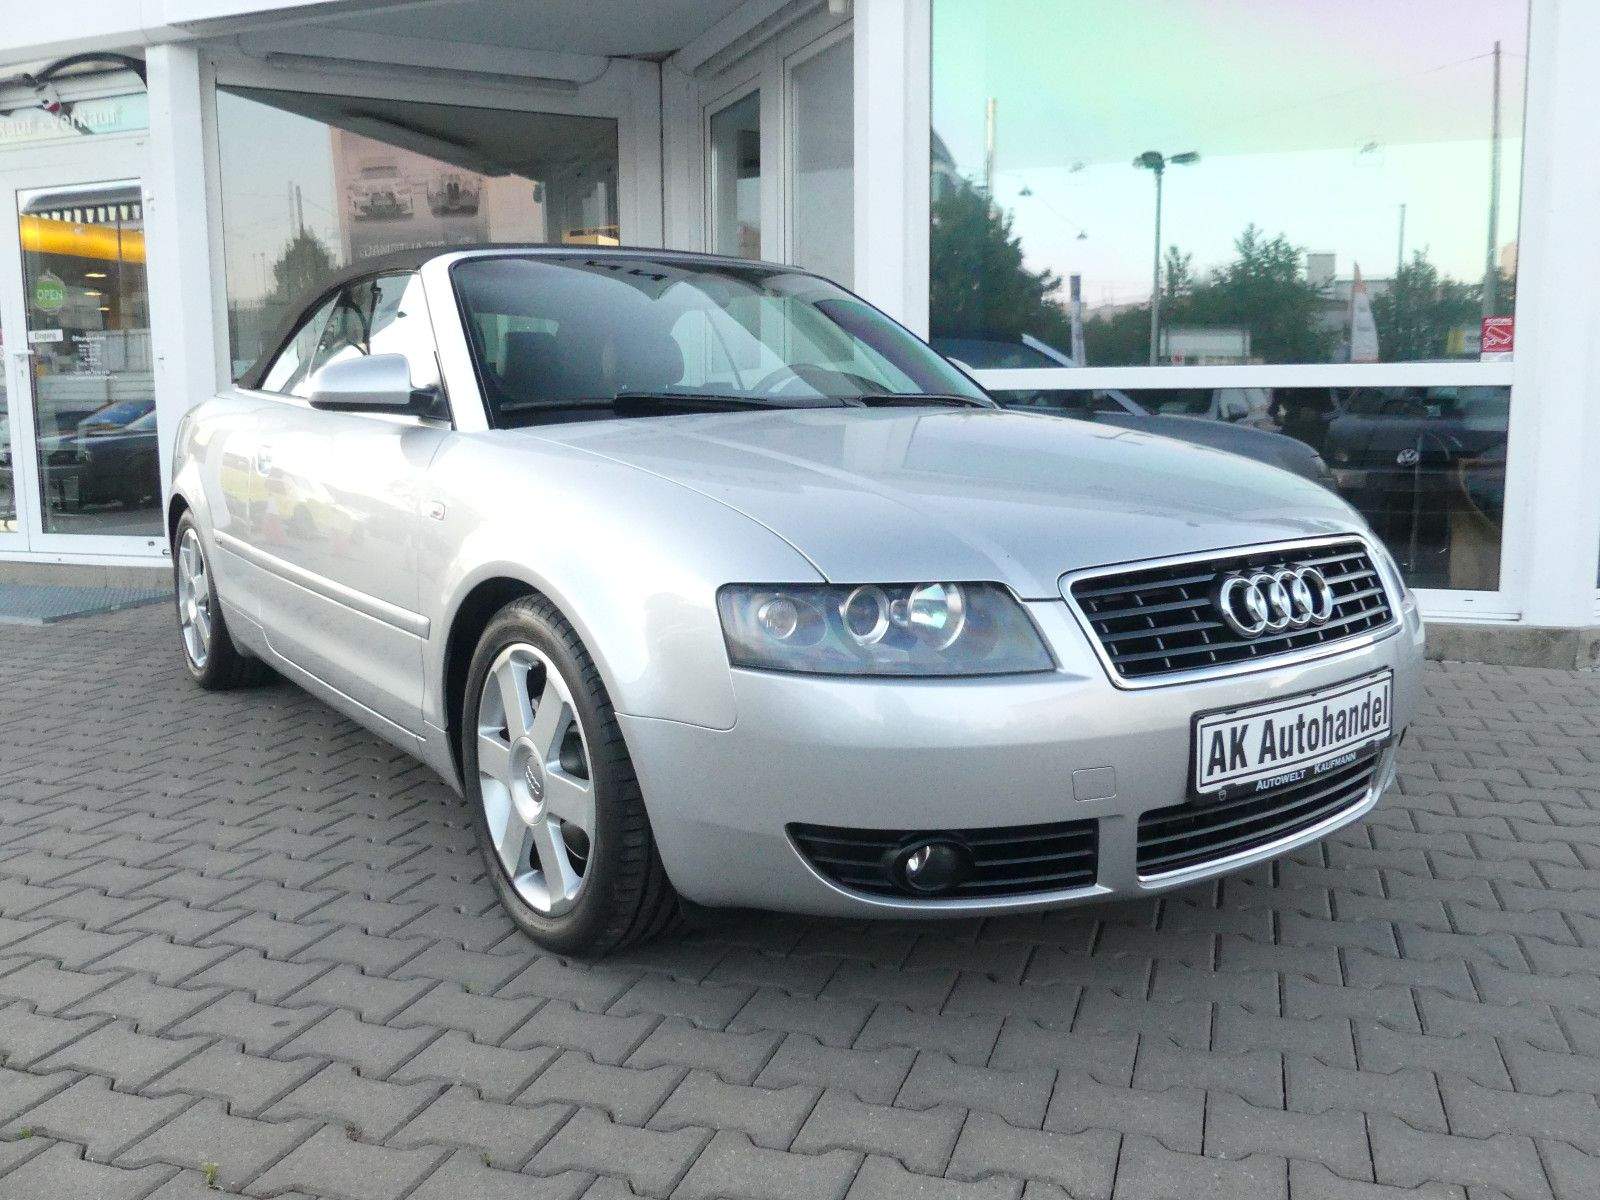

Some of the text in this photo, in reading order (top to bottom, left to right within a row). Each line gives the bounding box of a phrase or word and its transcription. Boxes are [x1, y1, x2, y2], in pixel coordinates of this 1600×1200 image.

[37, 289, 63, 300] OPEN
[1206, 684, 1388, 777] AK Autohandel
[1255, 751, 1357, 792] AUTOWELT KAUFMANN
